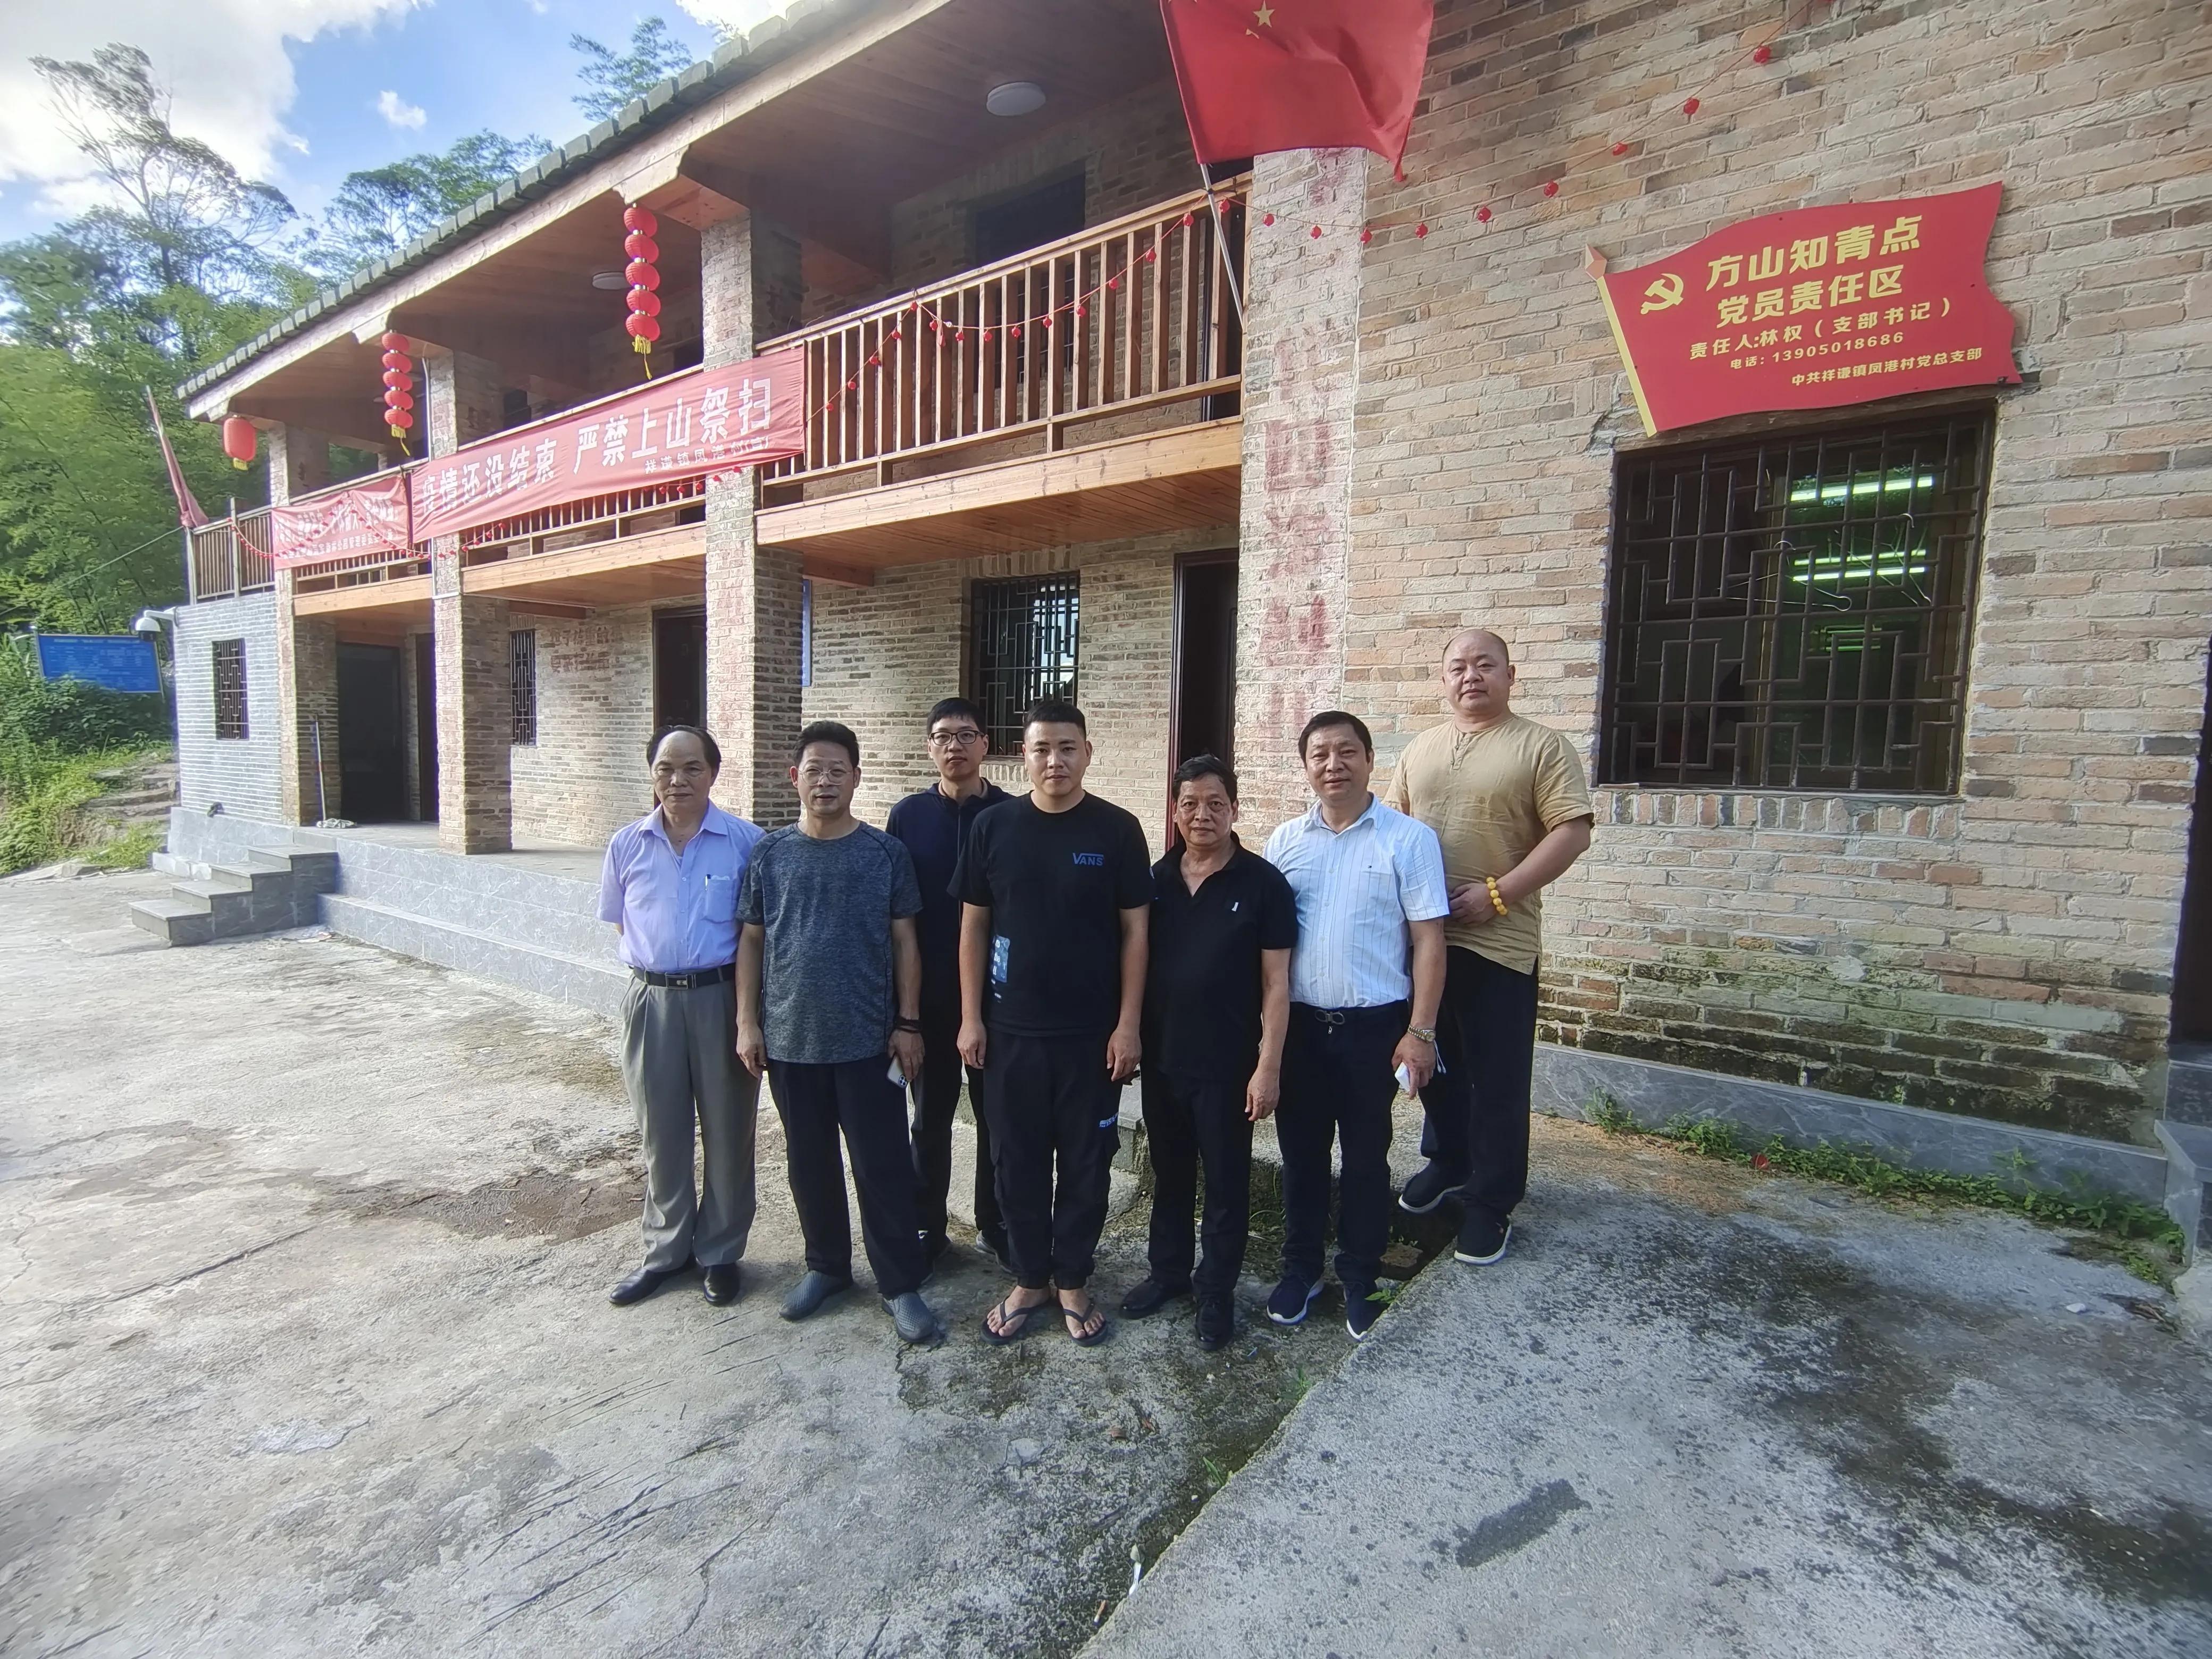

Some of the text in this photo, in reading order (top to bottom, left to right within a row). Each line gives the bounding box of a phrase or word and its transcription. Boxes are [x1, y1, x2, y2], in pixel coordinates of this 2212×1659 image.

[1705, 215, 1923, 292] 方山知青点
[1716, 264, 1904, 329] 党员责任区
[1791, 347, 1983, 386] 中共祥谦镇凤港村党总支部
[421, 378, 772, 515] 疫情还没结束 严禁上山祭扫
[1072, 852, 1104, 866] VANS
